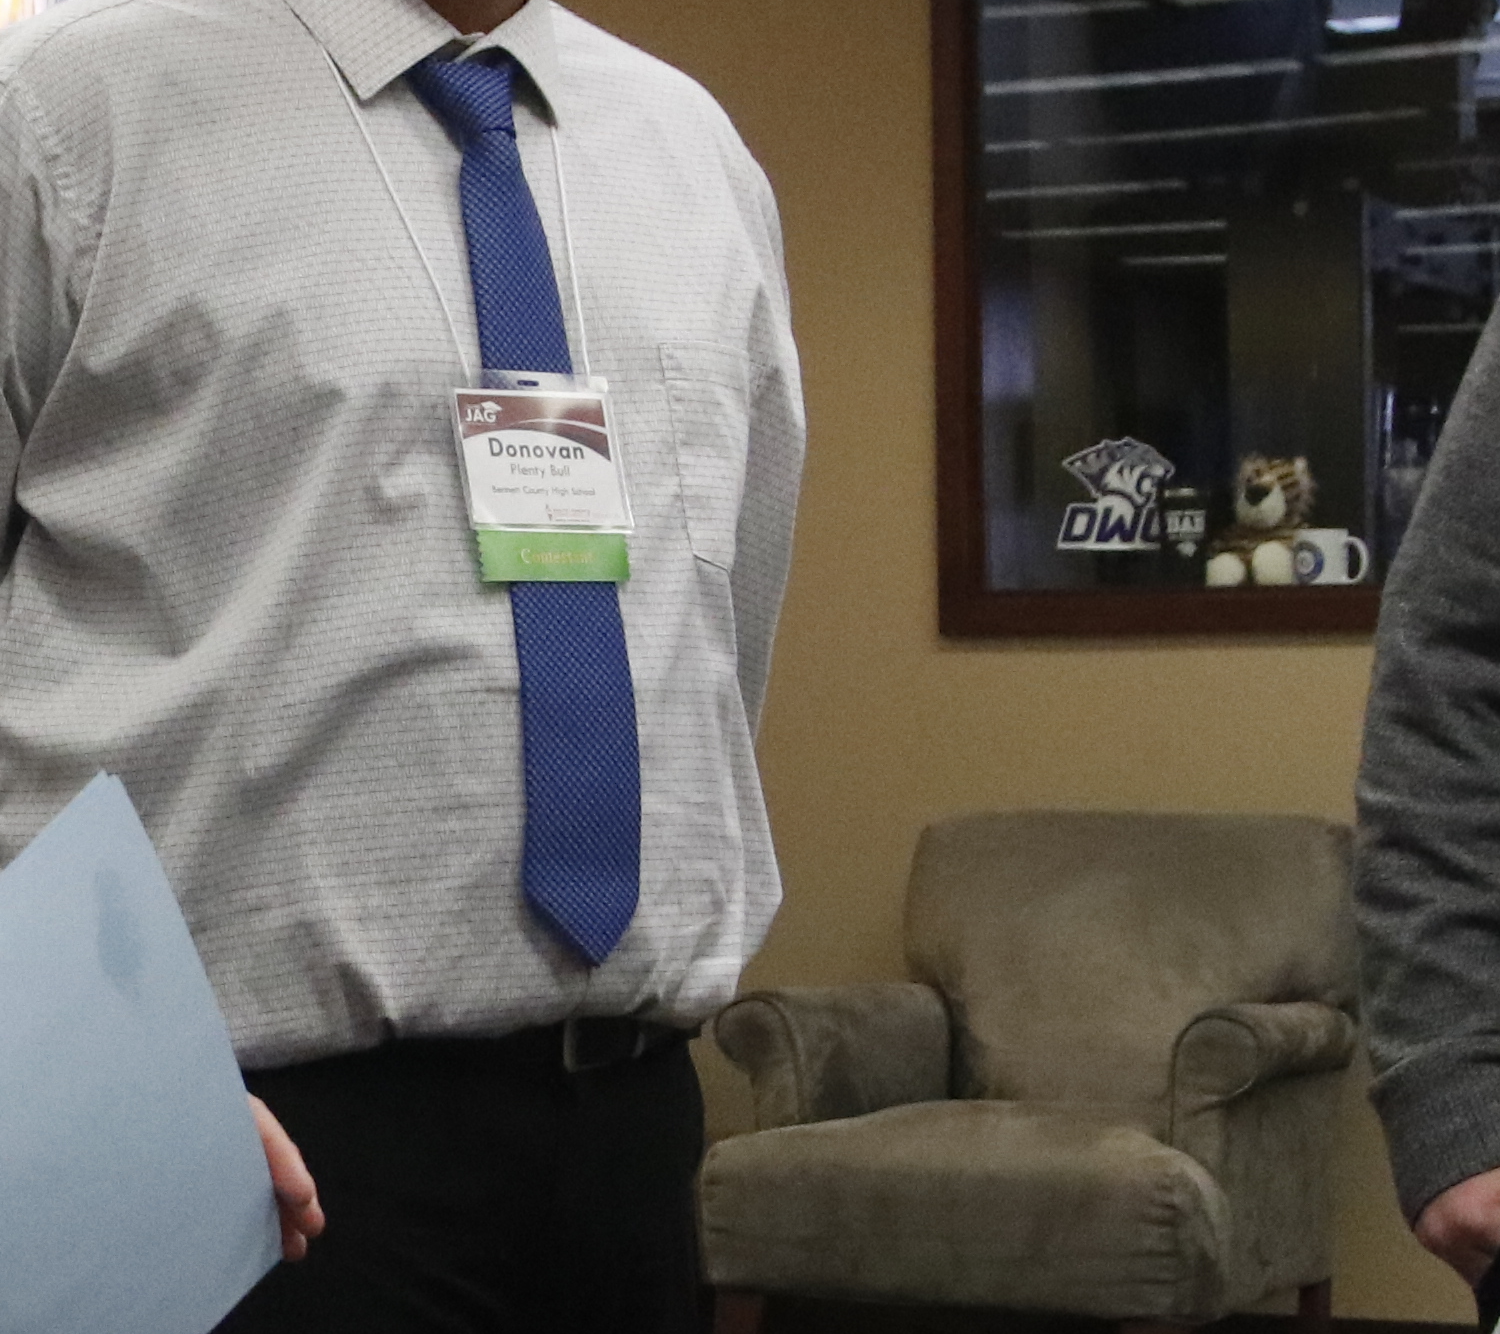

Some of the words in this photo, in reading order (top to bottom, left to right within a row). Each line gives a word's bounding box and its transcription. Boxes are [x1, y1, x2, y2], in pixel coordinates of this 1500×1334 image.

[465, 407, 498, 424] JAG
[488, 437, 585, 460] Donovan
[510, 464, 545, 478] Plenty
[550, 465, 571, 477] Bull
